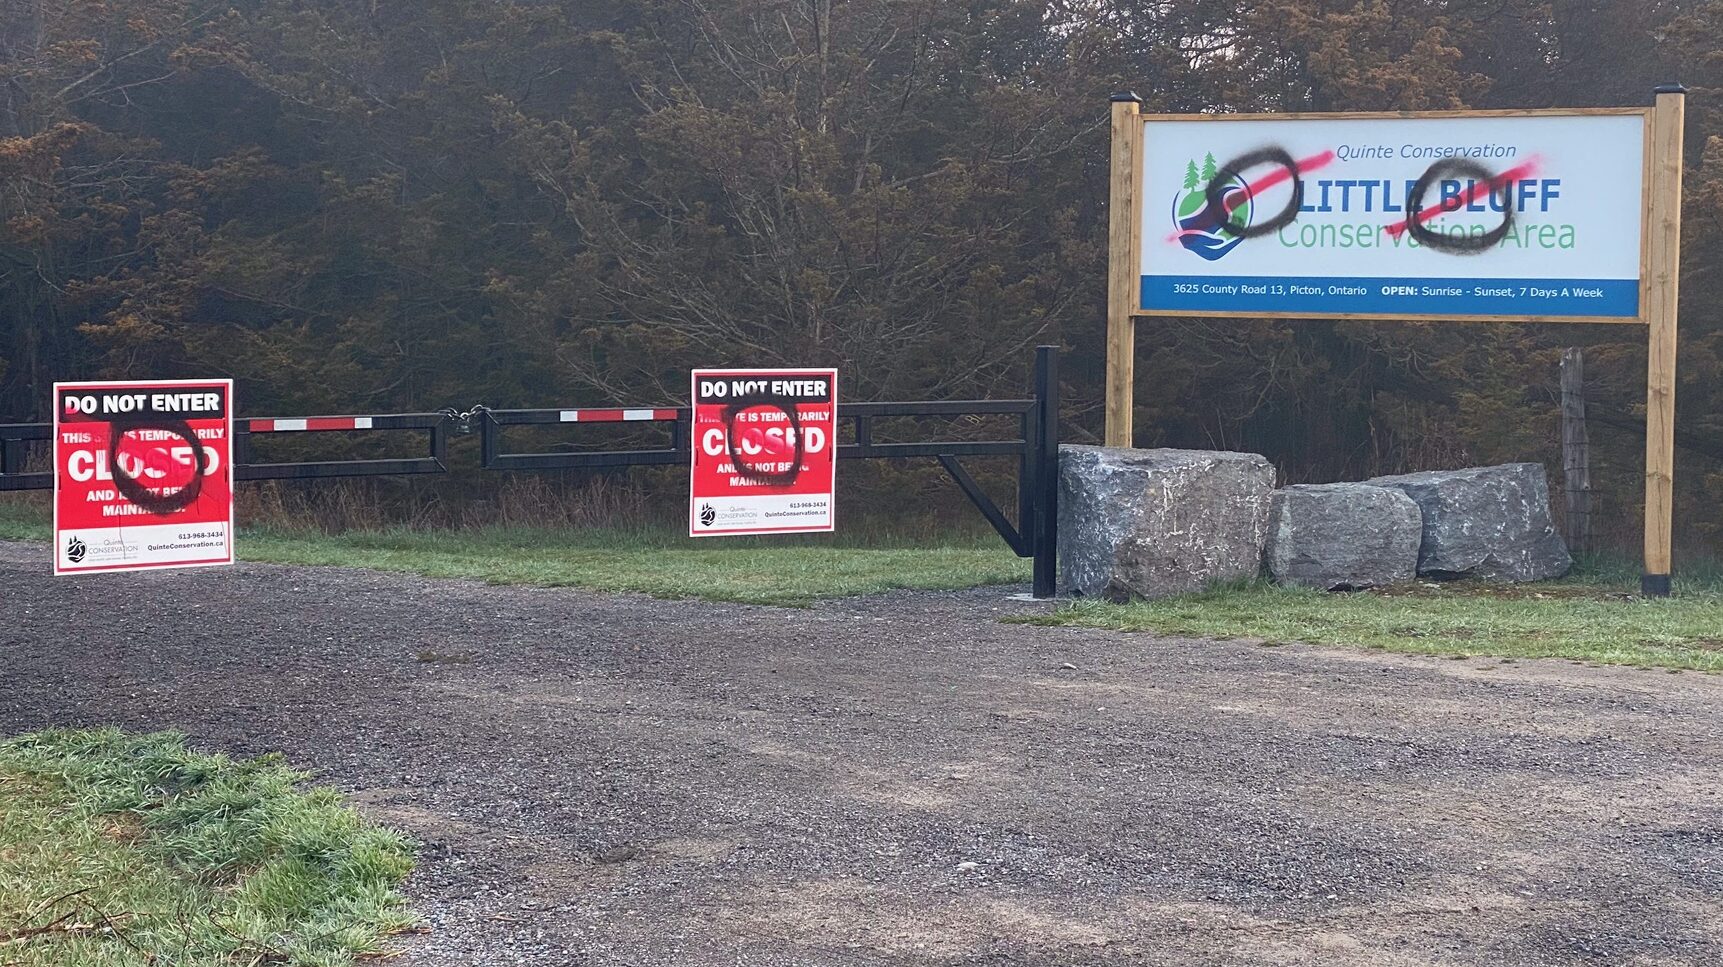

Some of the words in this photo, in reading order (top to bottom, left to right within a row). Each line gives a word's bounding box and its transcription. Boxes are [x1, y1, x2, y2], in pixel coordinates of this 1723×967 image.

[1337, 144, 1394, 161] Quinte
[1400, 144, 1516, 159] Conservation
[1440, 179, 1561, 213] BLUFF
[1500, 217, 1575, 249] Area
[1173, 284, 1199, 294] 3625
[1202, 284, 1237, 296] County
[1241, 285, 1267, 294] Road
[1270, 285, 1287, 296] 13,
[1290, 285, 1325, 296] Picton,
[1328, 286, 1367, 296] Ontario
[1381, 286, 1418, 296] OPEN:
[1422, 286, 1462, 296] Sunrise
[1474, 287, 1515, 298] Sunset,
[1520, 288, 1526, 297] 7
[1531, 288, 1557, 299] Days
[1561, 288, 1569, 297] A
[1572, 288, 1603, 298] Week
[701, 381, 728, 398] DO
[732, 380, 768, 397] NOT
[771, 380, 827, 397] ENTER
[65, 395, 97, 414] DO
[103, 394, 147, 413] NOT
[151, 393, 219, 412] ENTER
[748, 412, 759, 422] IS
[760, 412, 830, 422] TEMPRARILY
[62, 432, 91, 444] THIS
[139, 428, 224, 441] TEMPORILY
[755, 462, 776, 472] NOT
[86, 490, 115, 501] AND
[764, 509, 827, 518] QuinteConservation.ca
[178, 531, 223, 540] 613-968-3434
[88, 545, 138, 555] CONSERVATION
[148, 541, 223, 552] QuinteConservation.ca
